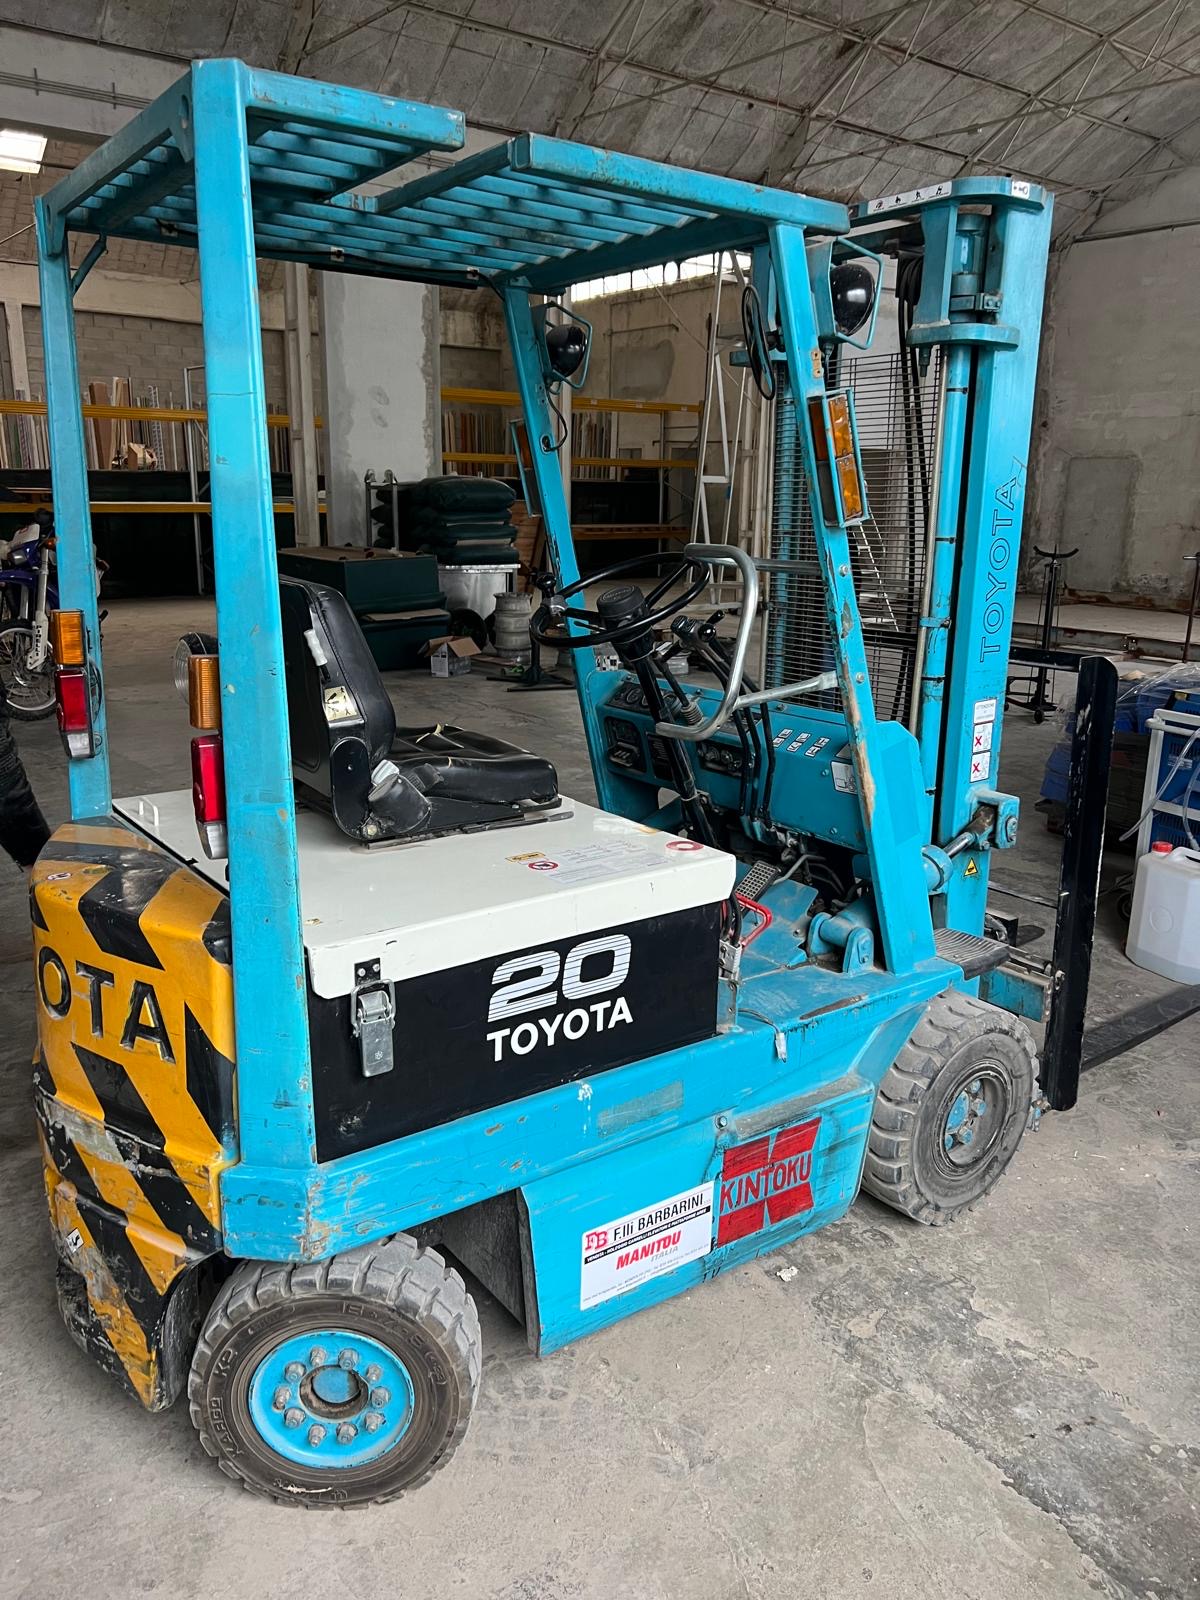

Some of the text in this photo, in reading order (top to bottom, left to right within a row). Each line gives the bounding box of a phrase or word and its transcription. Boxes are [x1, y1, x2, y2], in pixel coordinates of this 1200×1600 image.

[979, 477, 1017, 663] TOYOTA
[488, 934, 631, 1022] 20
[486, 996, 633, 1062] TOYOTA
[720, 1152, 812, 1212] KINTOKU
[585, 1193, 703, 1251] FB F.lli BARBARINI
[616, 1231, 681, 1270] MANITOU
[651, 1246, 679, 1262] ITALIA
